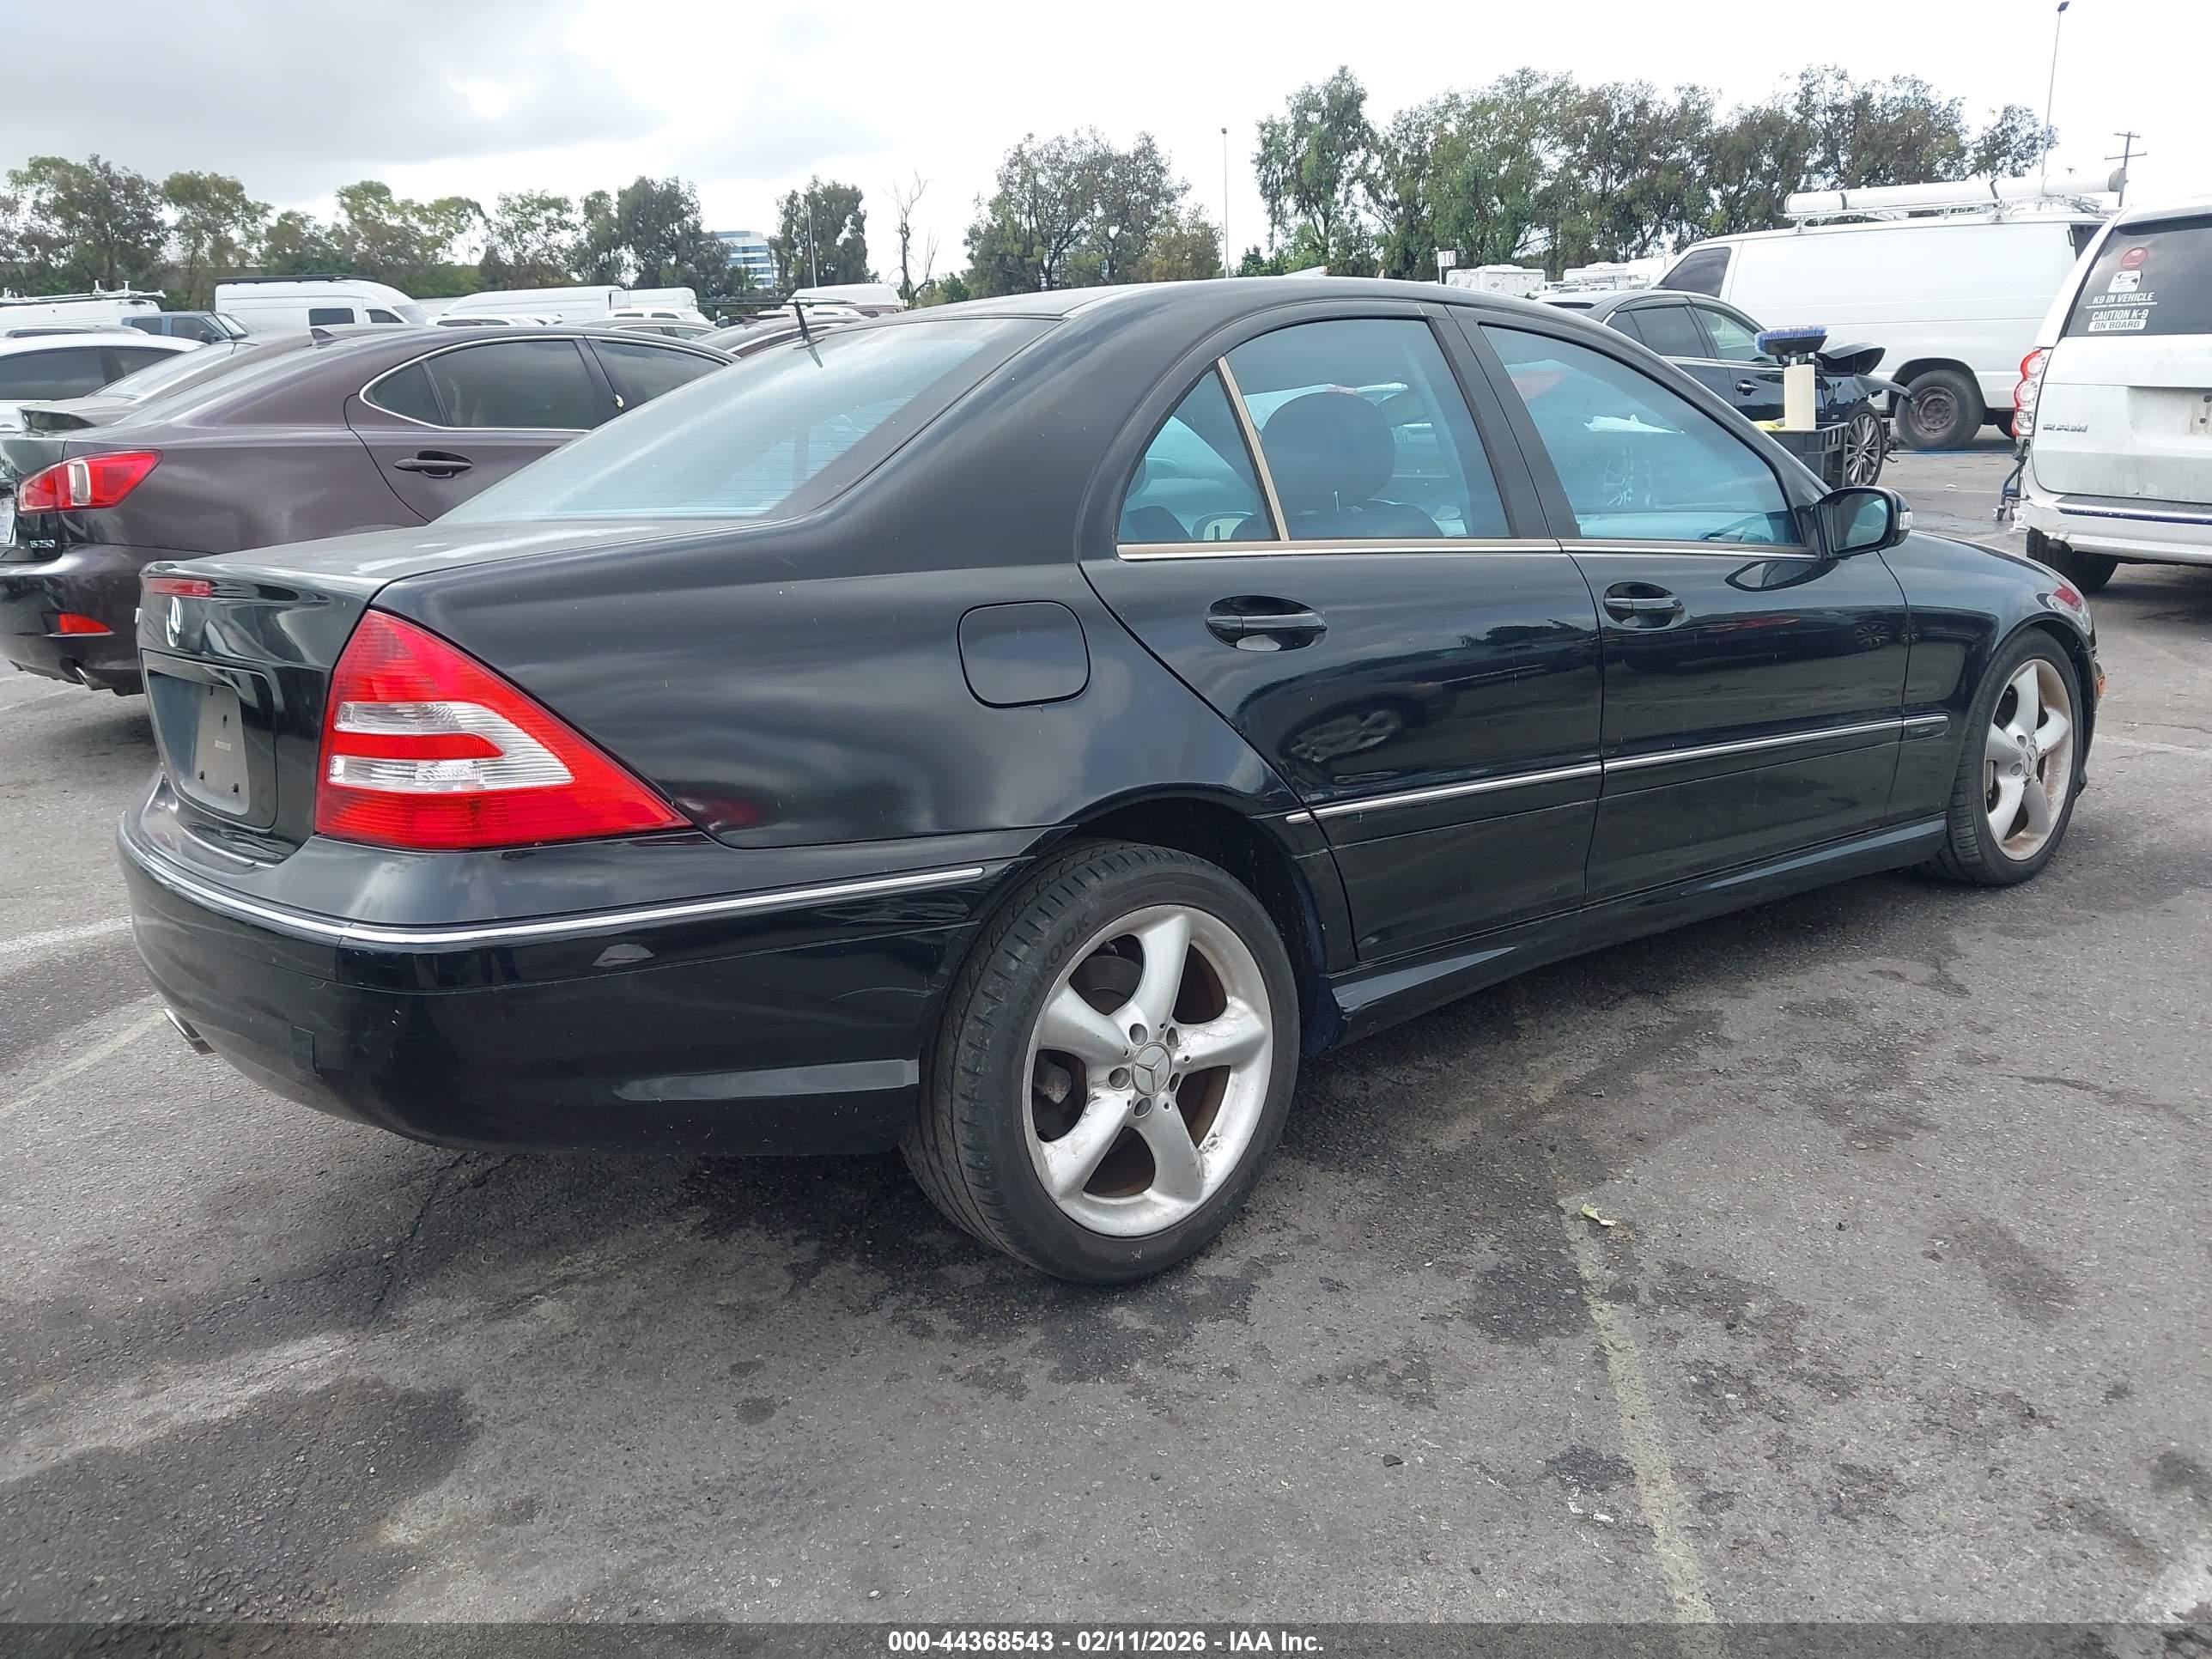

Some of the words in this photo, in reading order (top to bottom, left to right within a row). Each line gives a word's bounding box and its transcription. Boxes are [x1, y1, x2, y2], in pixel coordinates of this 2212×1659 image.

[1443, 252, 1455, 265] 10
[2093, 295, 2106, 305] K9
[2106, 294, 2116, 303] IN
[2118, 292, 2155, 303] VEHICLE
[2092, 309, 2130, 320] CAUTION
[2131, 308, 2149, 319] K-9
[2109, 320, 2141, 329] BOARD
[2043, 423, 2088, 433] RAM
